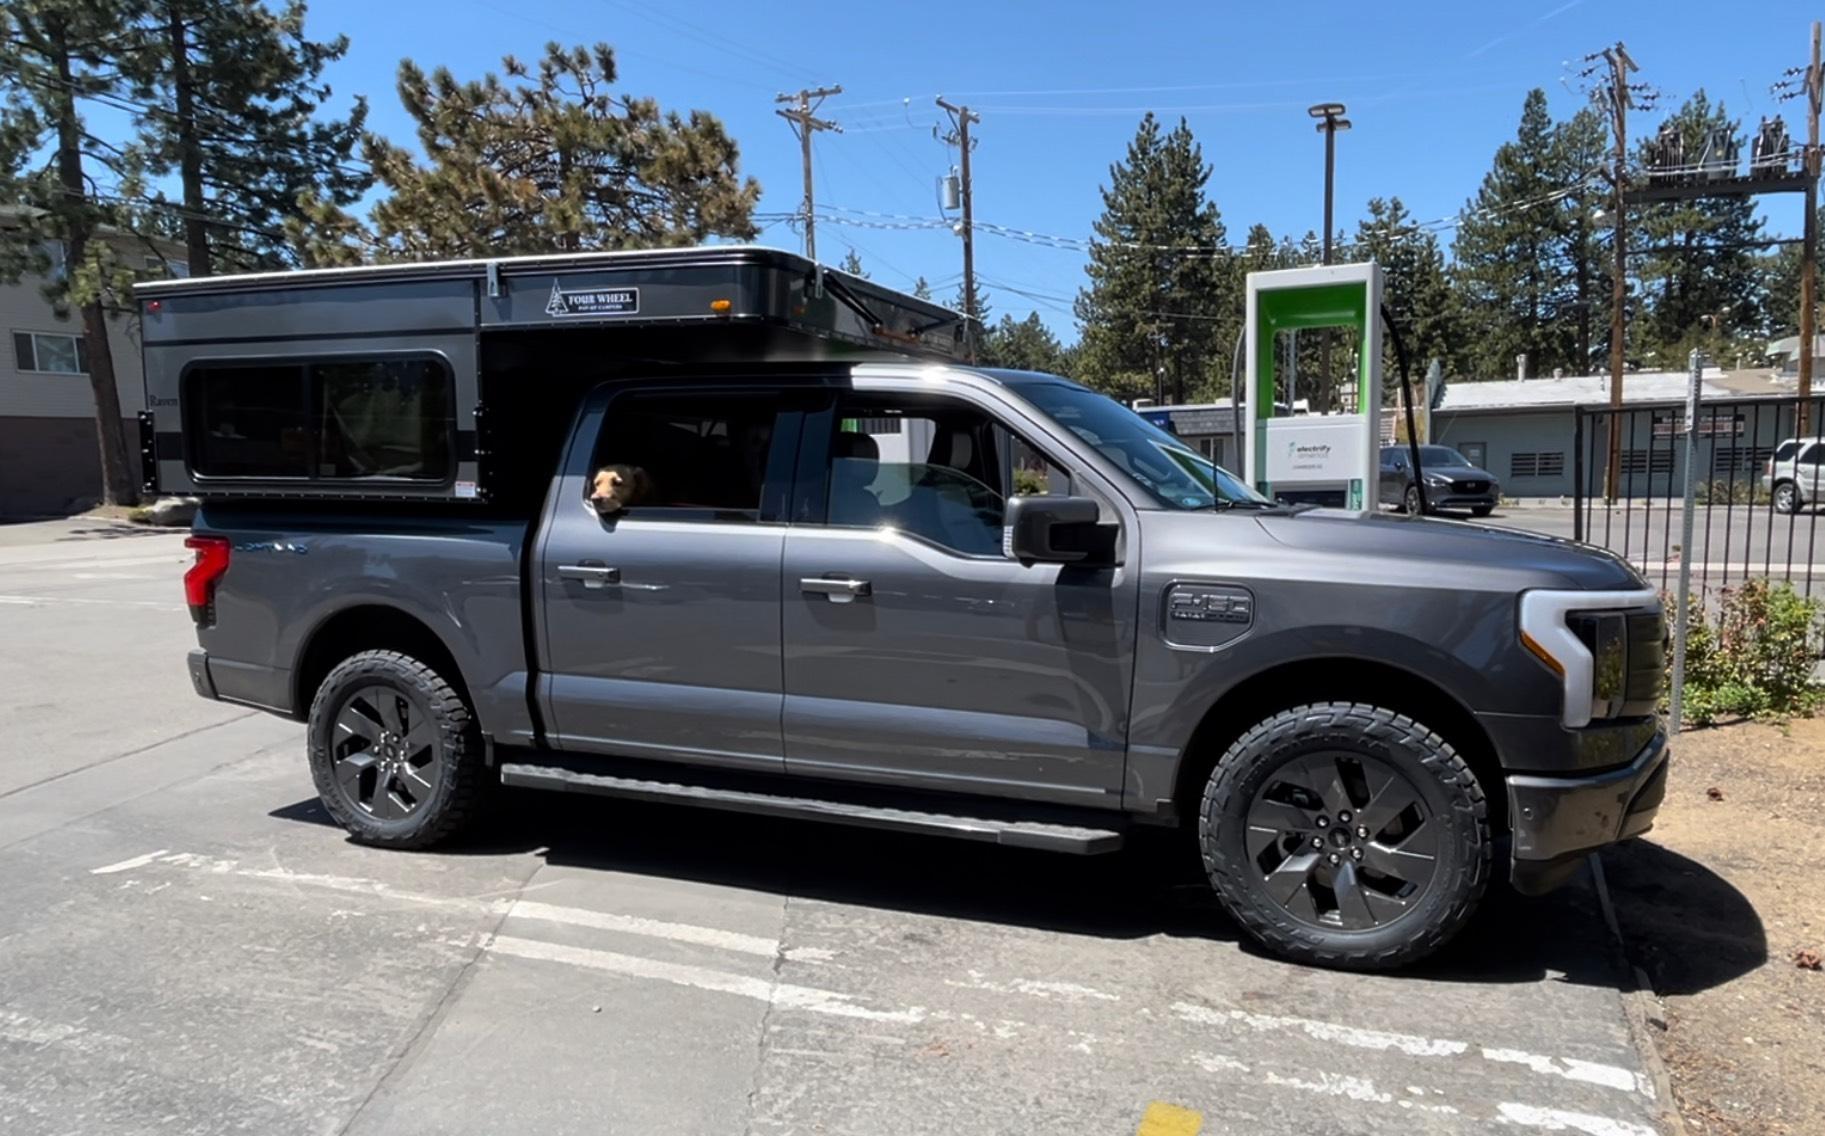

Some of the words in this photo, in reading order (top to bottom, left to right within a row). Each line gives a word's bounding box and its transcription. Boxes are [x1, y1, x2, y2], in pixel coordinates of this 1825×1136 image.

[568, 294, 595, 305] FOUR
[597, 293, 633, 303] WHEEL
[1297, 445, 1331, 454] electrify
